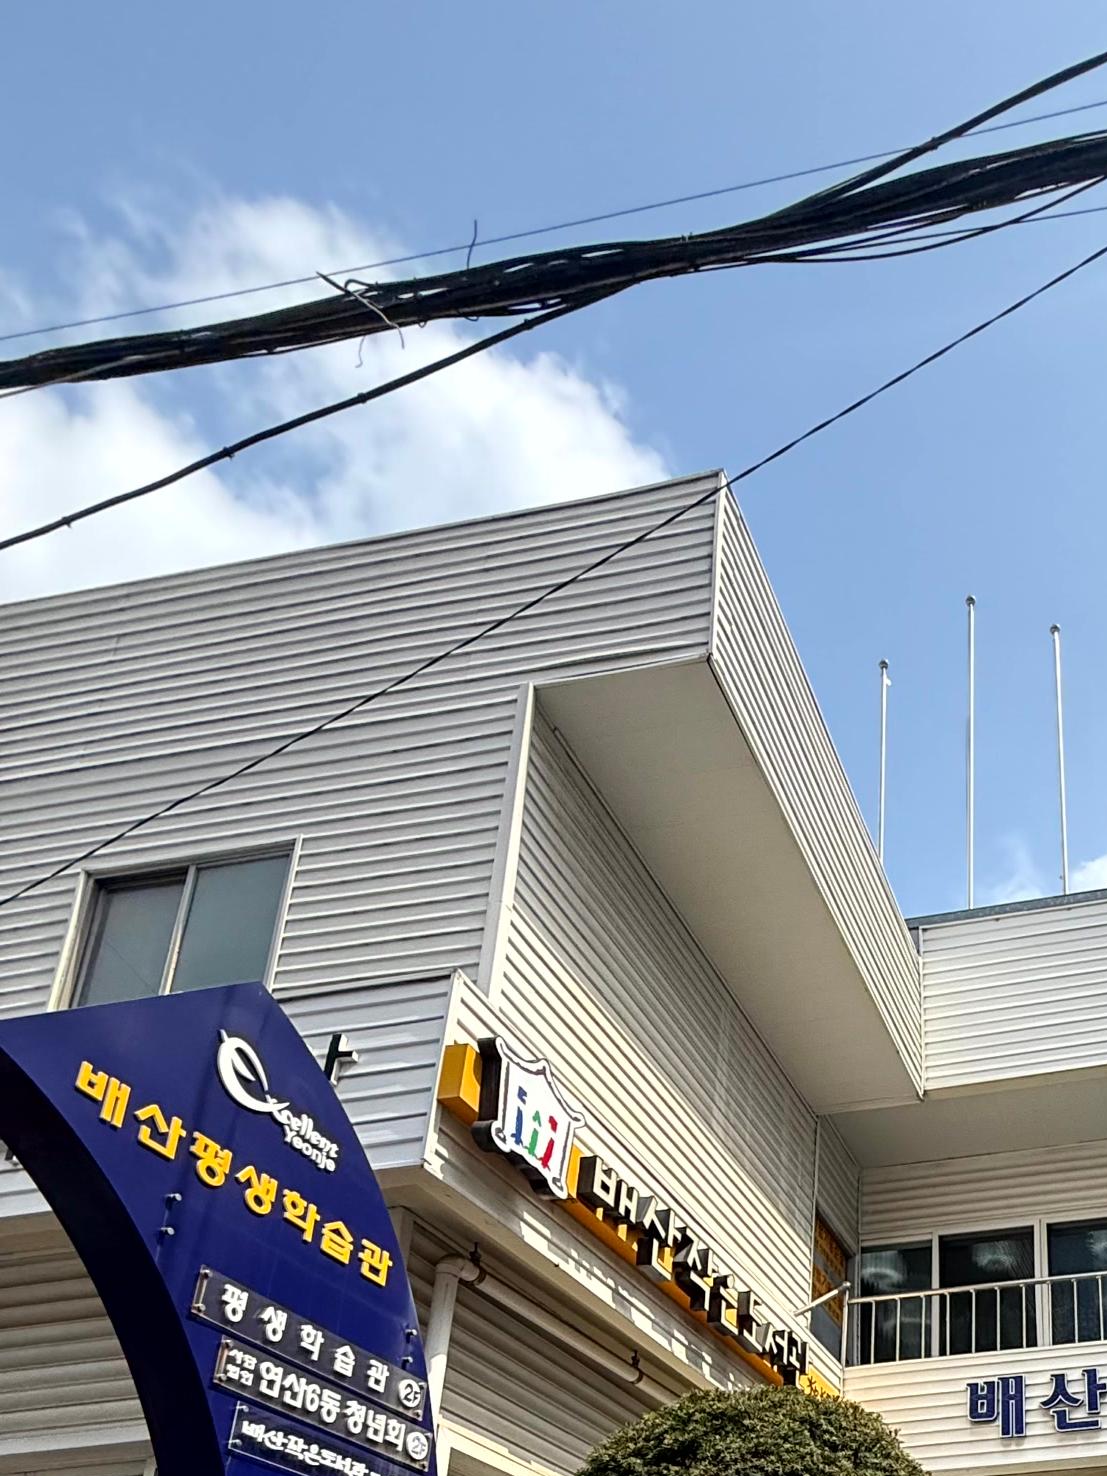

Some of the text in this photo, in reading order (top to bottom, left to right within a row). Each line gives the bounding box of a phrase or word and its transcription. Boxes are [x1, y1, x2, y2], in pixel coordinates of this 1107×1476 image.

[75, 1060, 393, 1288] 배산평생학습관
[284, 1124, 337, 1173] Yeonje
[221, 1283, 390, 1394] 평생학습관
